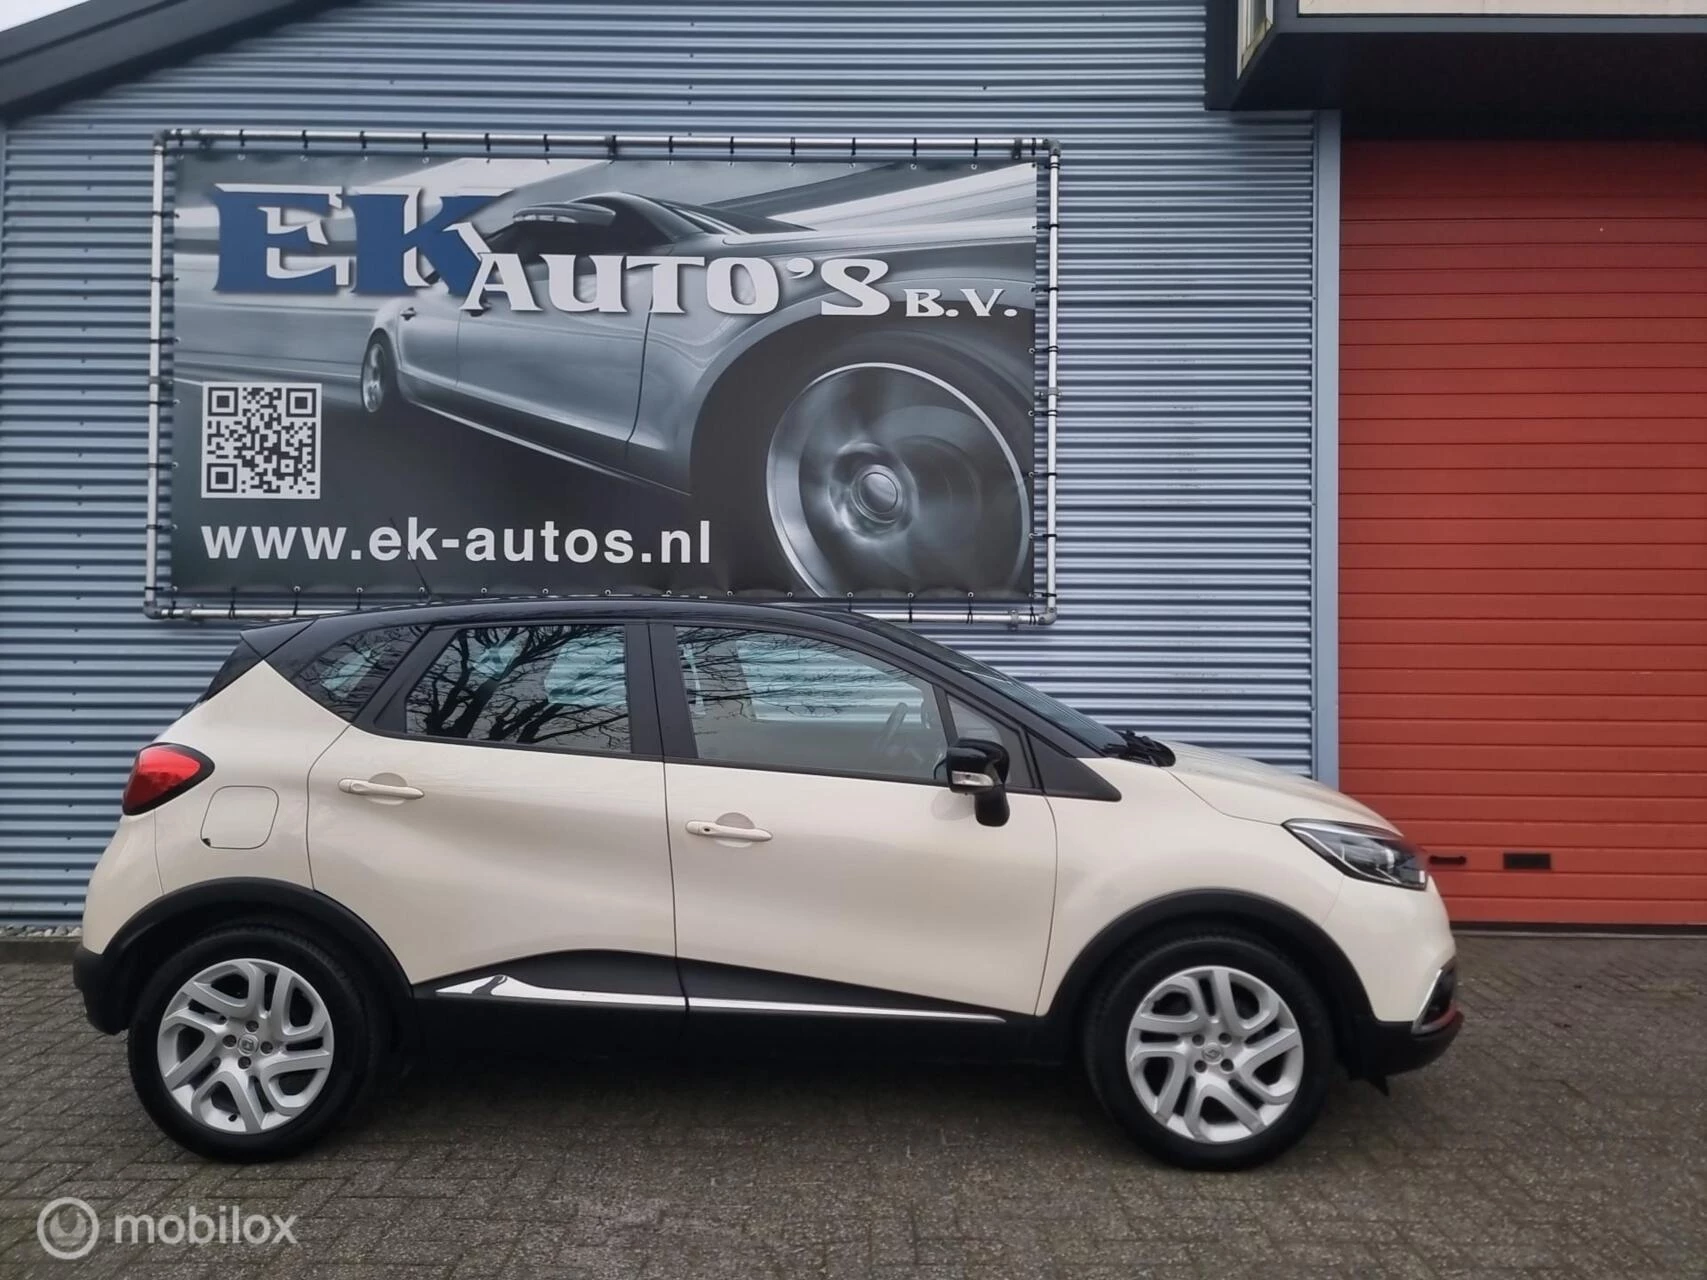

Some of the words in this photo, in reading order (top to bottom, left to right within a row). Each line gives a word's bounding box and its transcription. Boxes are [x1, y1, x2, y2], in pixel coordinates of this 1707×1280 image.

[213, 183, 514, 297] EK
[903, 288, 1018, 317] B.V.
[201, 517, 711, 564] www.ek-autos.nl
